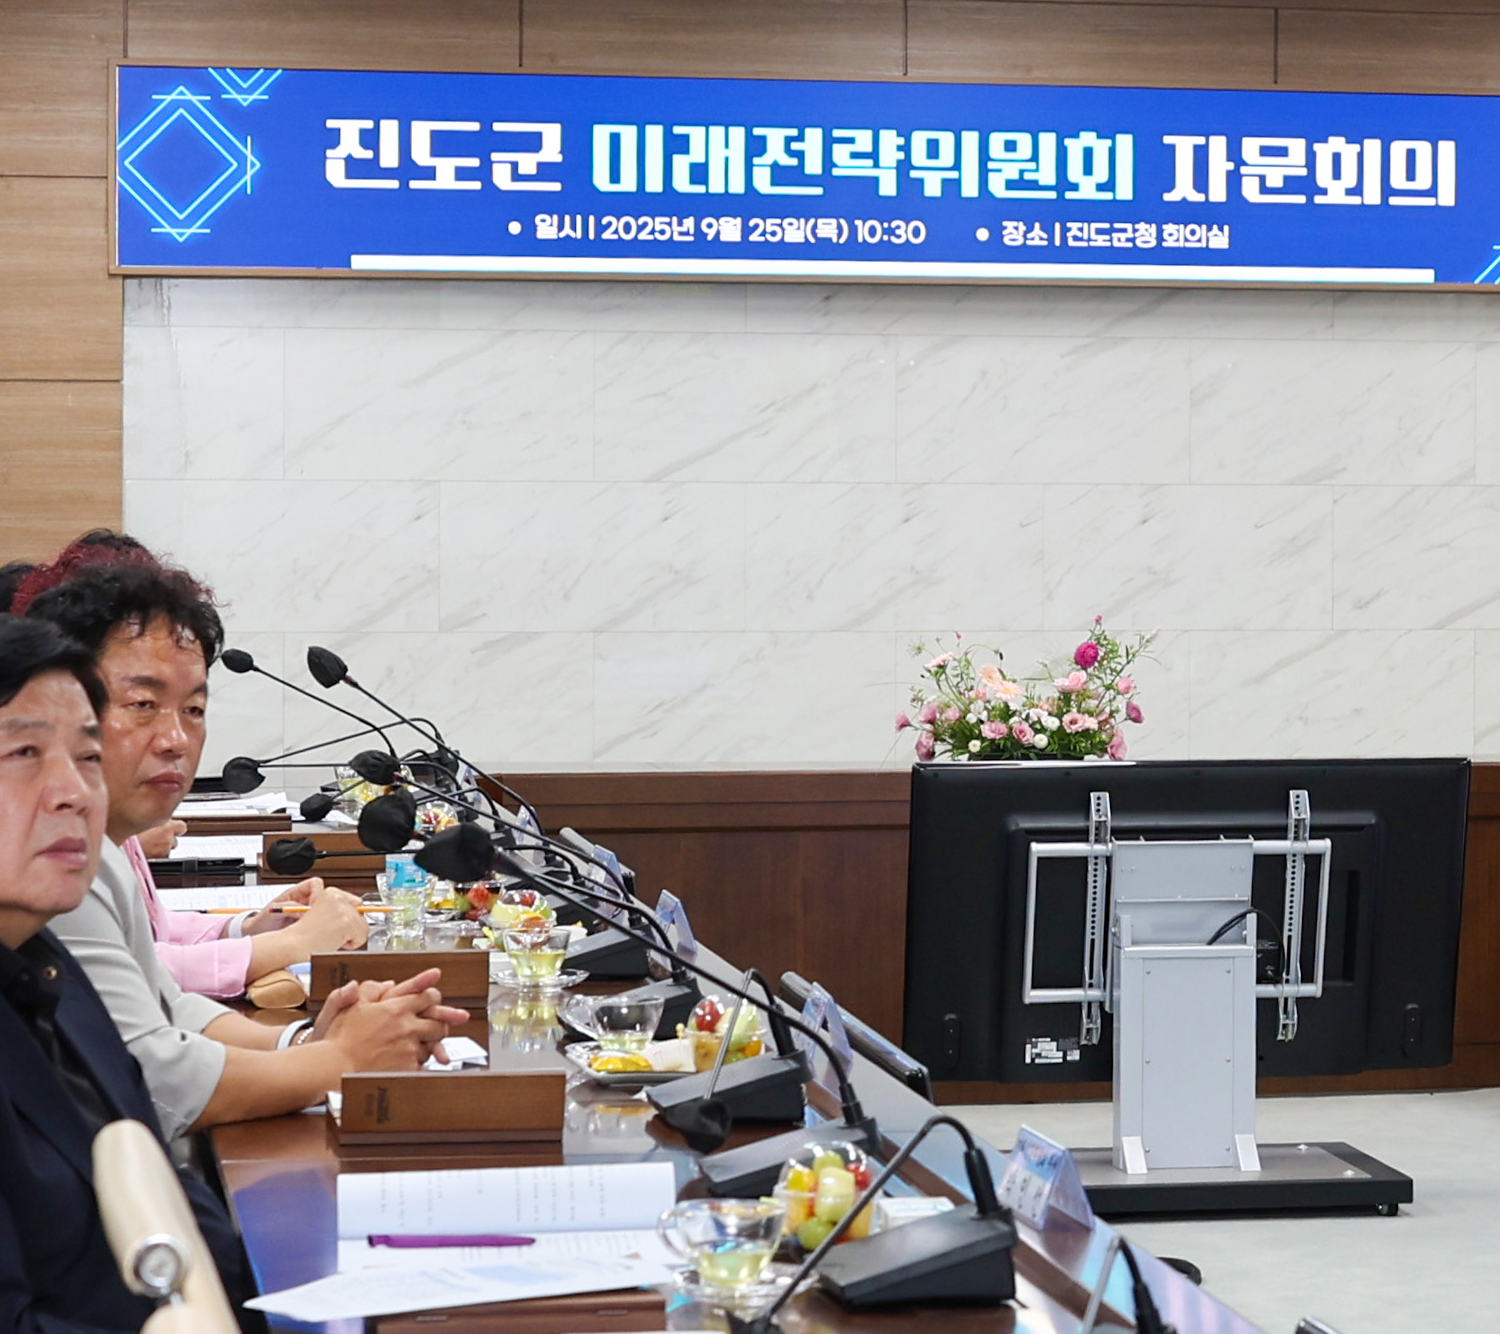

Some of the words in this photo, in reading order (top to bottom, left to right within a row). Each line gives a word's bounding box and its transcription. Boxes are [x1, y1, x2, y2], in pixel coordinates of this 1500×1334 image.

[325, 118, 563, 192] 진도군
[593, 123, 1134, 200] 미래전략위원회
[1162, 134, 1456, 207] 자문회의
[534, 213, 582, 241] 일시
[601, 216, 695, 242] 2025년
[701, 217, 742, 243] 9월
[748, 217, 849, 244] 25일(목)
[854, 219, 927, 245] 10:30
[1001, 220, 1048, 247] 장소
[1066, 220, 1157, 248] 진도군청
[1162, 223, 1230, 250] 회의실
